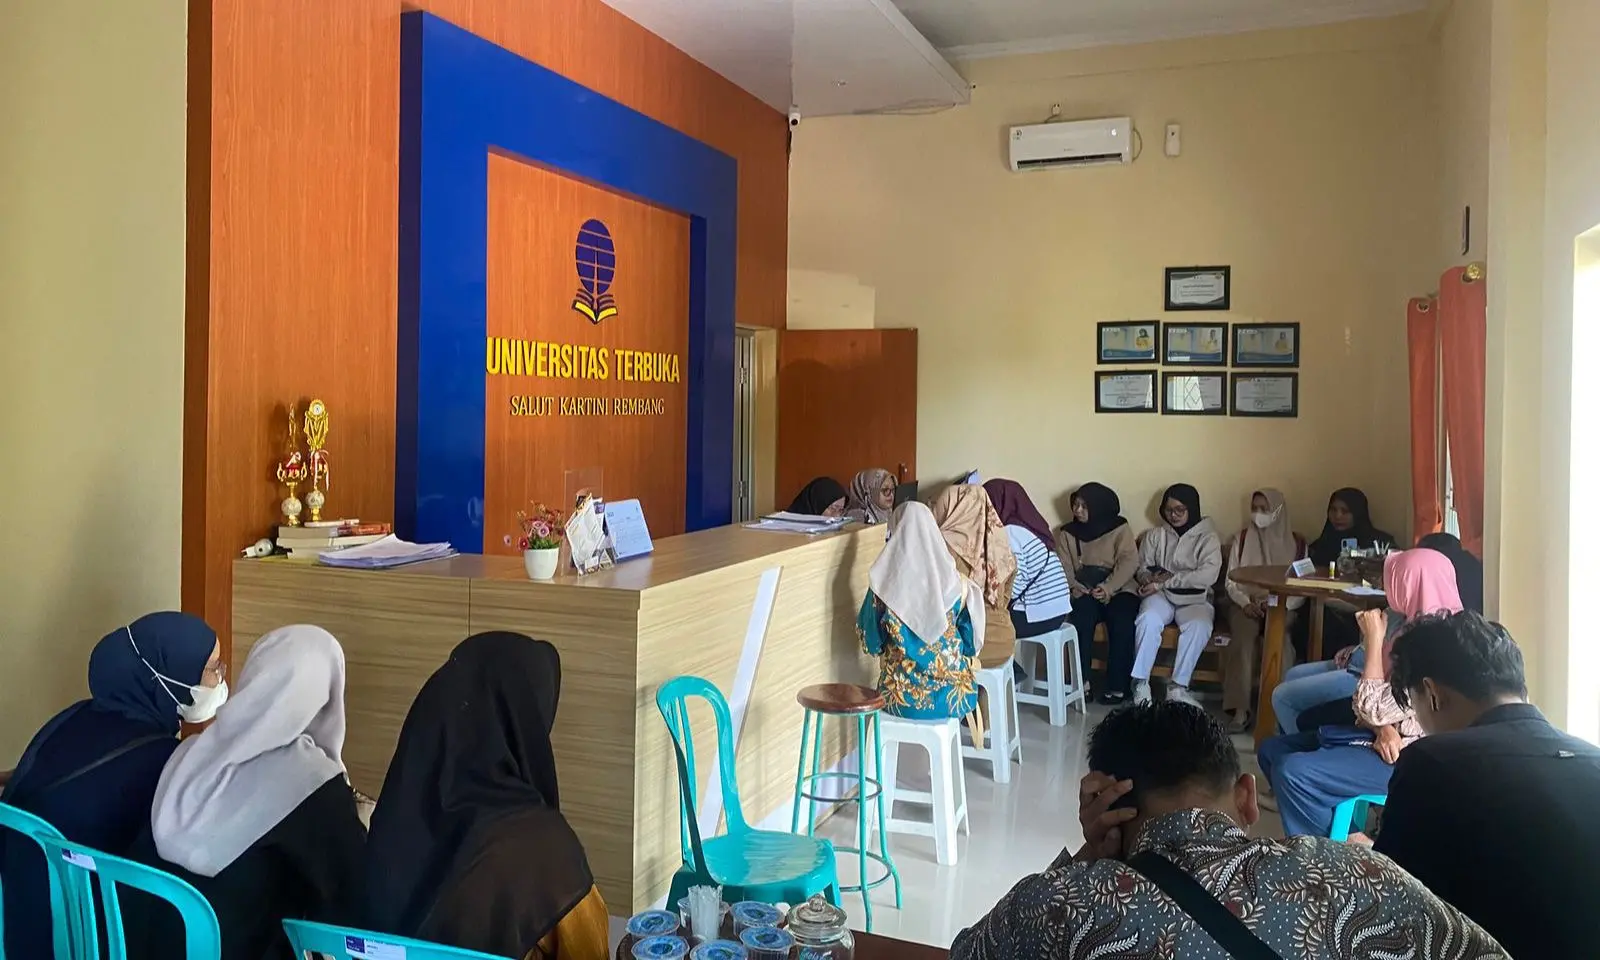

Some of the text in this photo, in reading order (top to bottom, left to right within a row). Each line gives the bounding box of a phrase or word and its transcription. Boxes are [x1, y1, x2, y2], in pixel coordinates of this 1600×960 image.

[486, 336, 680, 383] UNIVERSITAS TERBUKA
[510, 395, 665, 416] SALUT KARTINI REMBANG
